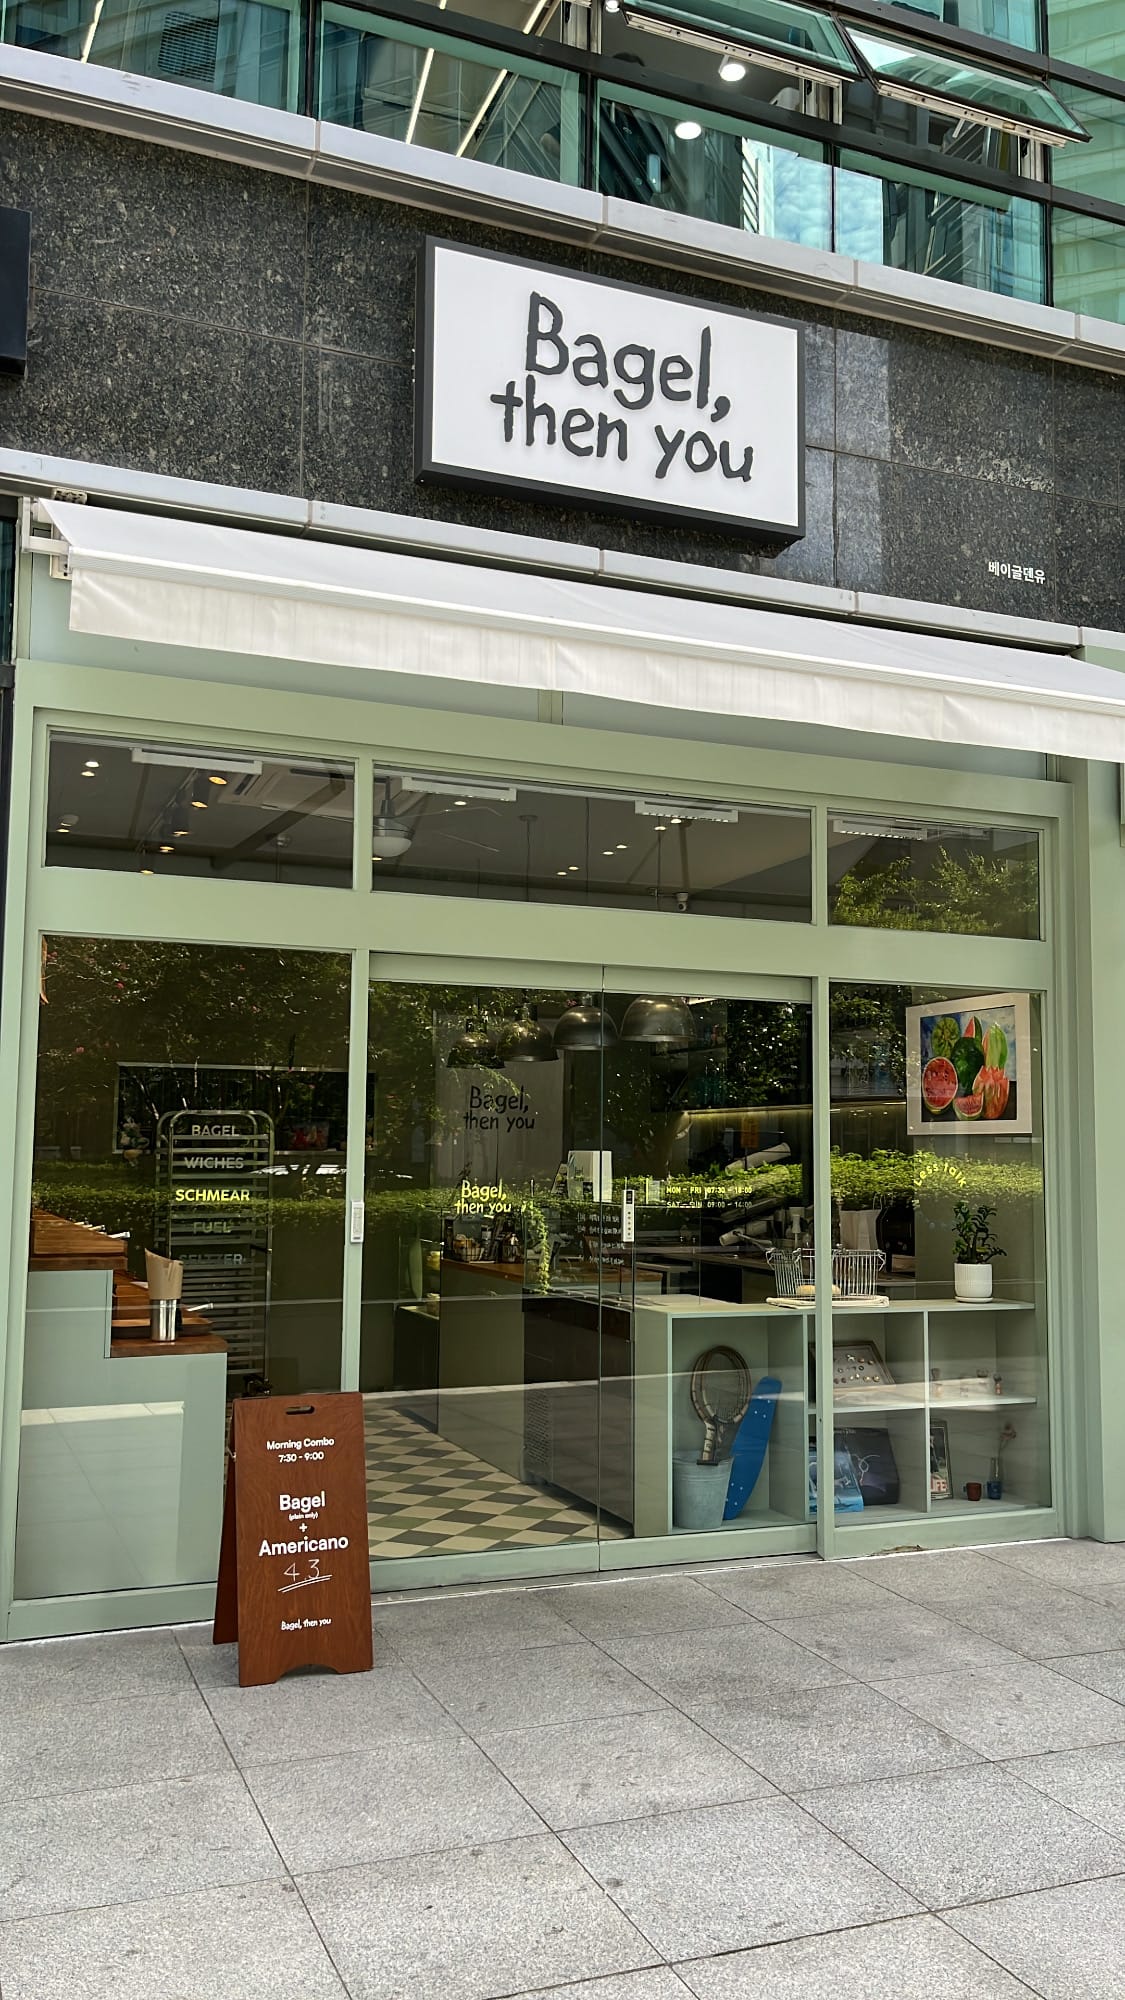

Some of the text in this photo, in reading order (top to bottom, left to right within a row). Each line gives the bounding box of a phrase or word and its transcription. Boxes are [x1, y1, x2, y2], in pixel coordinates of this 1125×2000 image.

[525, 291, 731, 423] Bagel,
[490, 374, 753, 482] then you
[988, 561, 1046, 585] 베이글덴유
[470, 1085, 529, 1114] Bagel,
[191, 1125, 240, 1137] BAGEL
[463, 1110, 535, 1133] then you
[184, 1157, 245, 1169] WICHES
[175, 1189, 250, 1202] SCHMEAR
[461, 1179, 507, 1202] Bagel,
[453, 1198, 512, 1215] then you
[193, 1222, 232, 1234] FUEL
[266, 1436, 335, 1450] Morning Combo
[278, 1453, 297, 1463] 7:30
[304, 1451, 324, 1461] 9:00
[279, 1490, 326, 1513] Bagel
[258, 1535, 349, 1557] Americano
[280, 1618, 332, 1631] Bagel, then you
